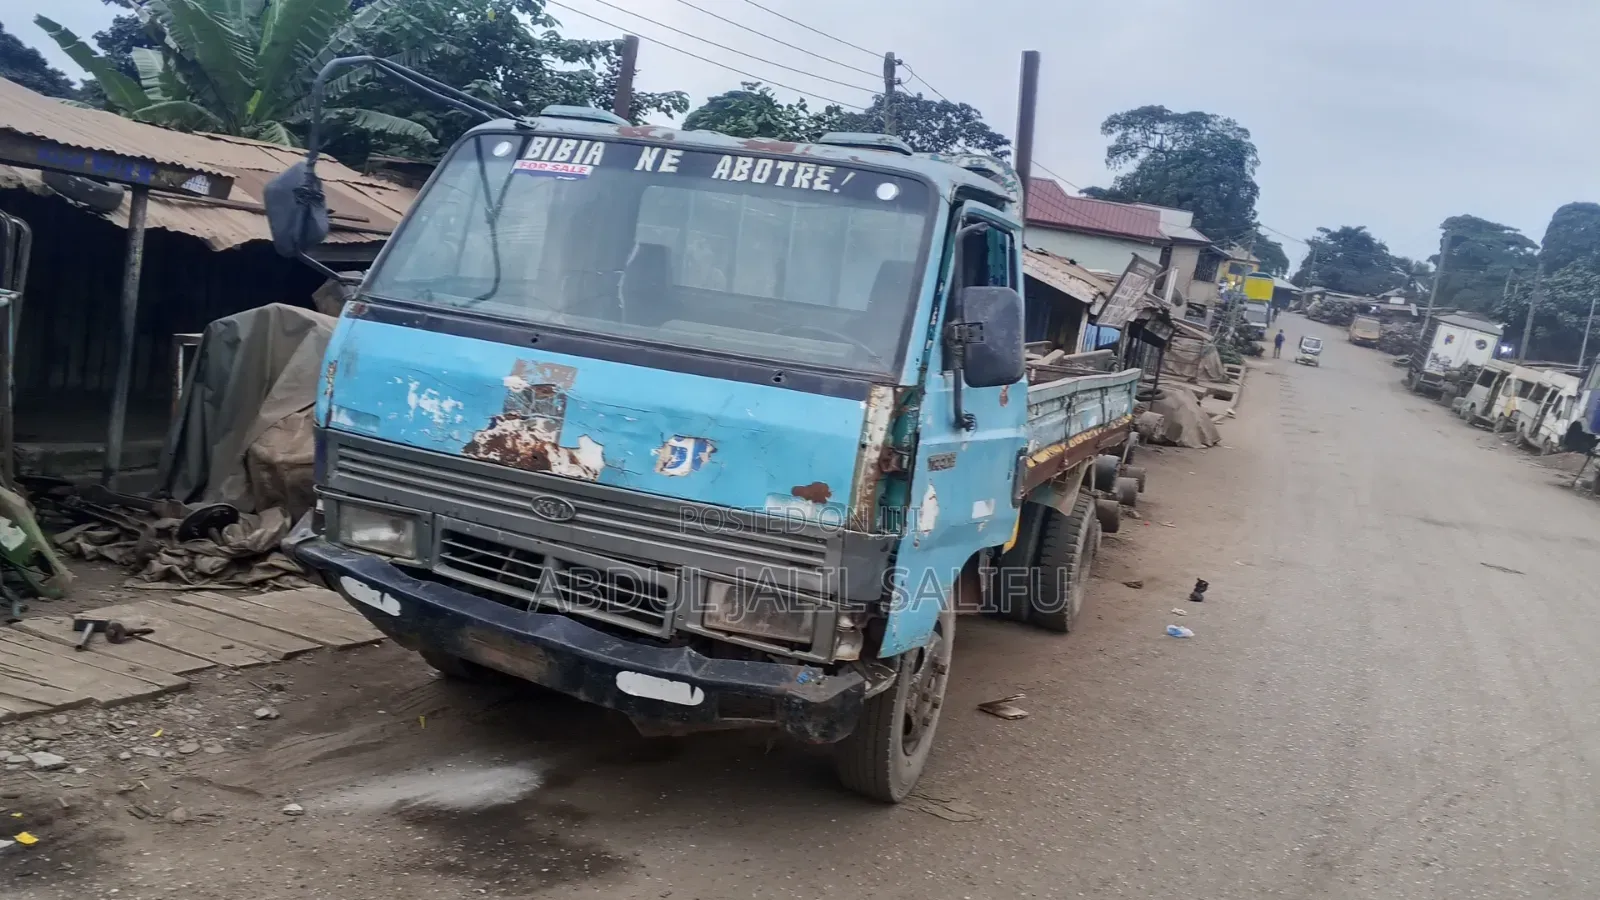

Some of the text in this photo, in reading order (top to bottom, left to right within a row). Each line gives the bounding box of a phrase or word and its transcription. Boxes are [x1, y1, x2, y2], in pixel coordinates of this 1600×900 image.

[520, 161, 588, 174] FOR SALE
[523, 136, 856, 194] BIBIA NE ABOTRE!
